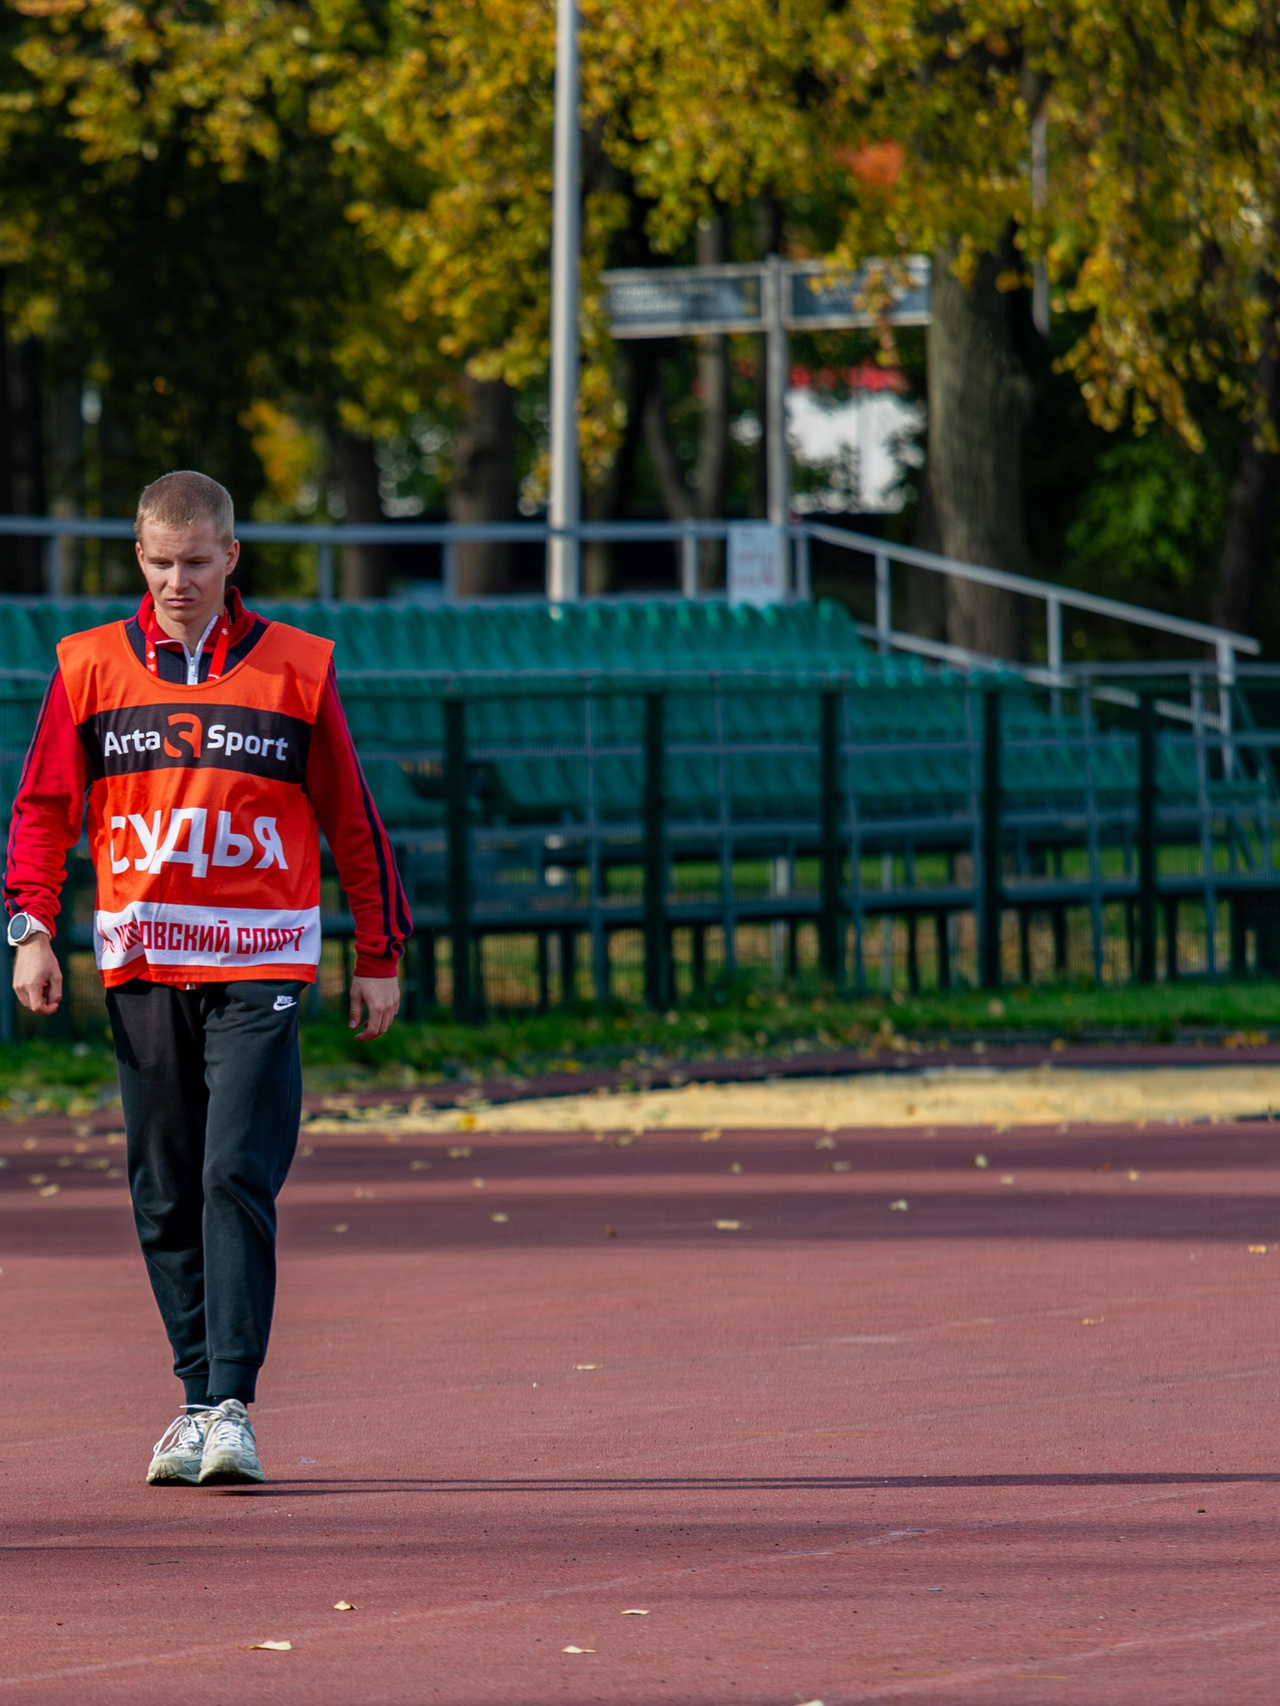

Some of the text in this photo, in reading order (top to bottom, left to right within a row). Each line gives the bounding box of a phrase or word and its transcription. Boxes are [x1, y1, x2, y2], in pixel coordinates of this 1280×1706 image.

[104, 724, 289, 761] Arta Sport
[110, 807, 289, 878] СУДЬЯ
[236, 925, 306, 955] СПОРТ
